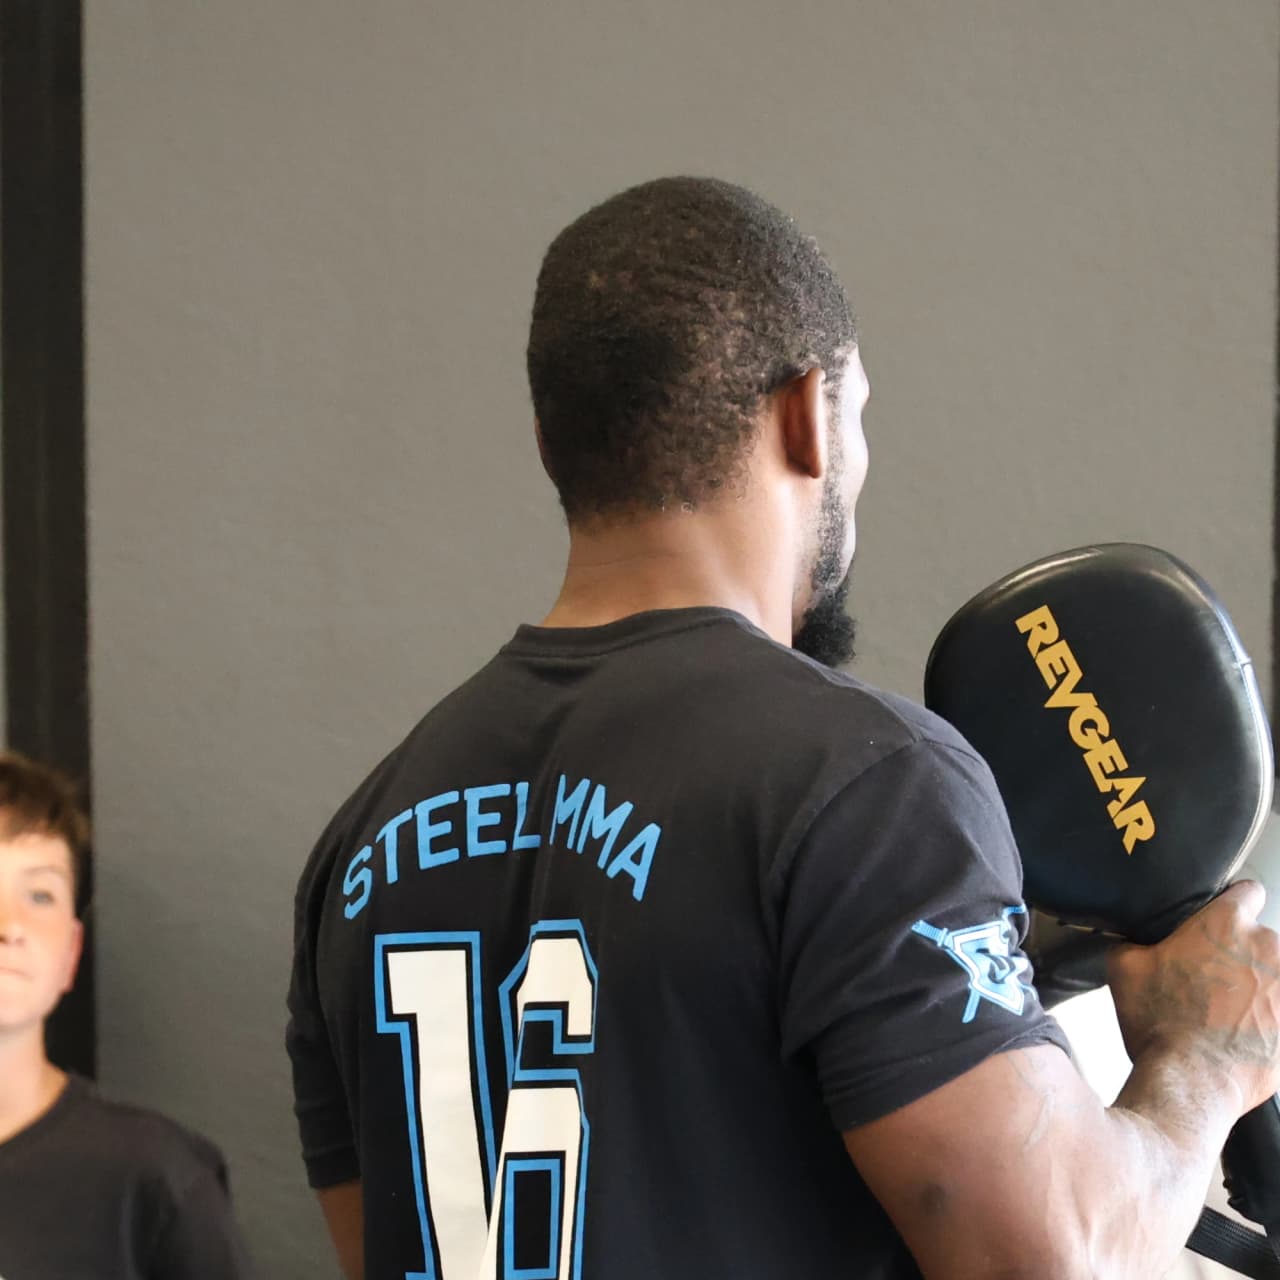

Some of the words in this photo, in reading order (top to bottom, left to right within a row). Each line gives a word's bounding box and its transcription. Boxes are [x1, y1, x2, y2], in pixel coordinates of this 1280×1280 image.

[1015, 604, 1156, 856] REVGEAR
[340, 781, 541, 920] STEEL
[548, 774, 662, 902] MMA
